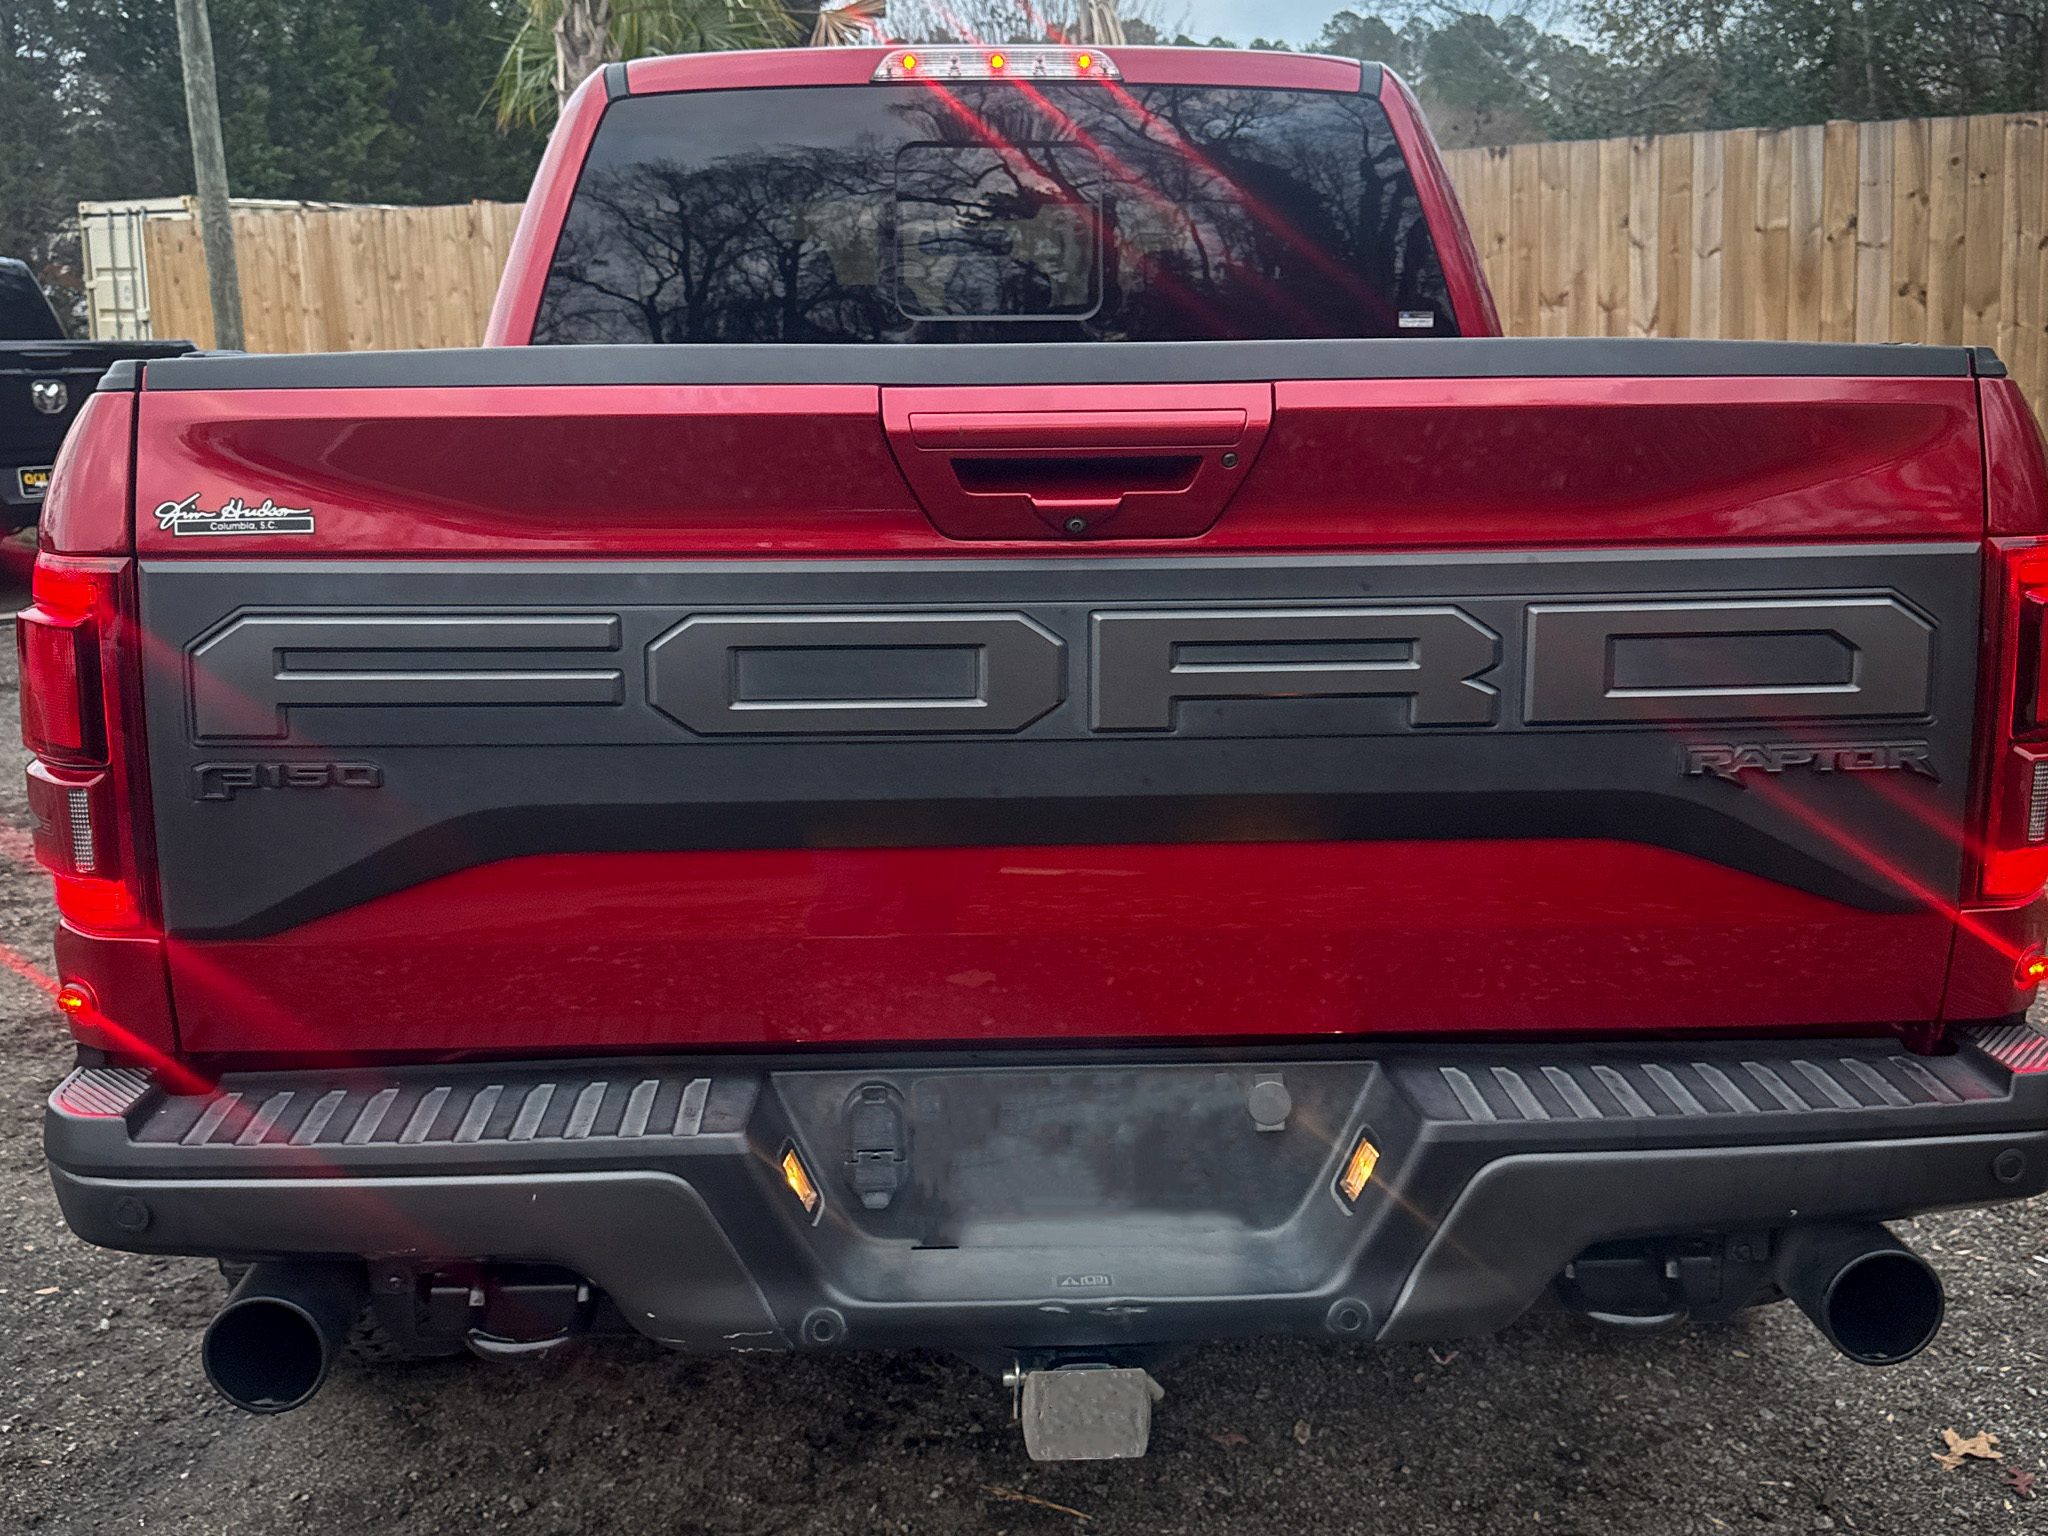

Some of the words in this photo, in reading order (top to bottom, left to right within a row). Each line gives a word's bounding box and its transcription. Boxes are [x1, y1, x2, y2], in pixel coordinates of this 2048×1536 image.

[154, 492, 216, 530] Jim
[221, 499, 311, 520] Hudson
[210, 521, 258, 531] Columbia,
[190, 594, 1936, 739] FORD
[1682, 739, 1940, 789] RAPTOR
